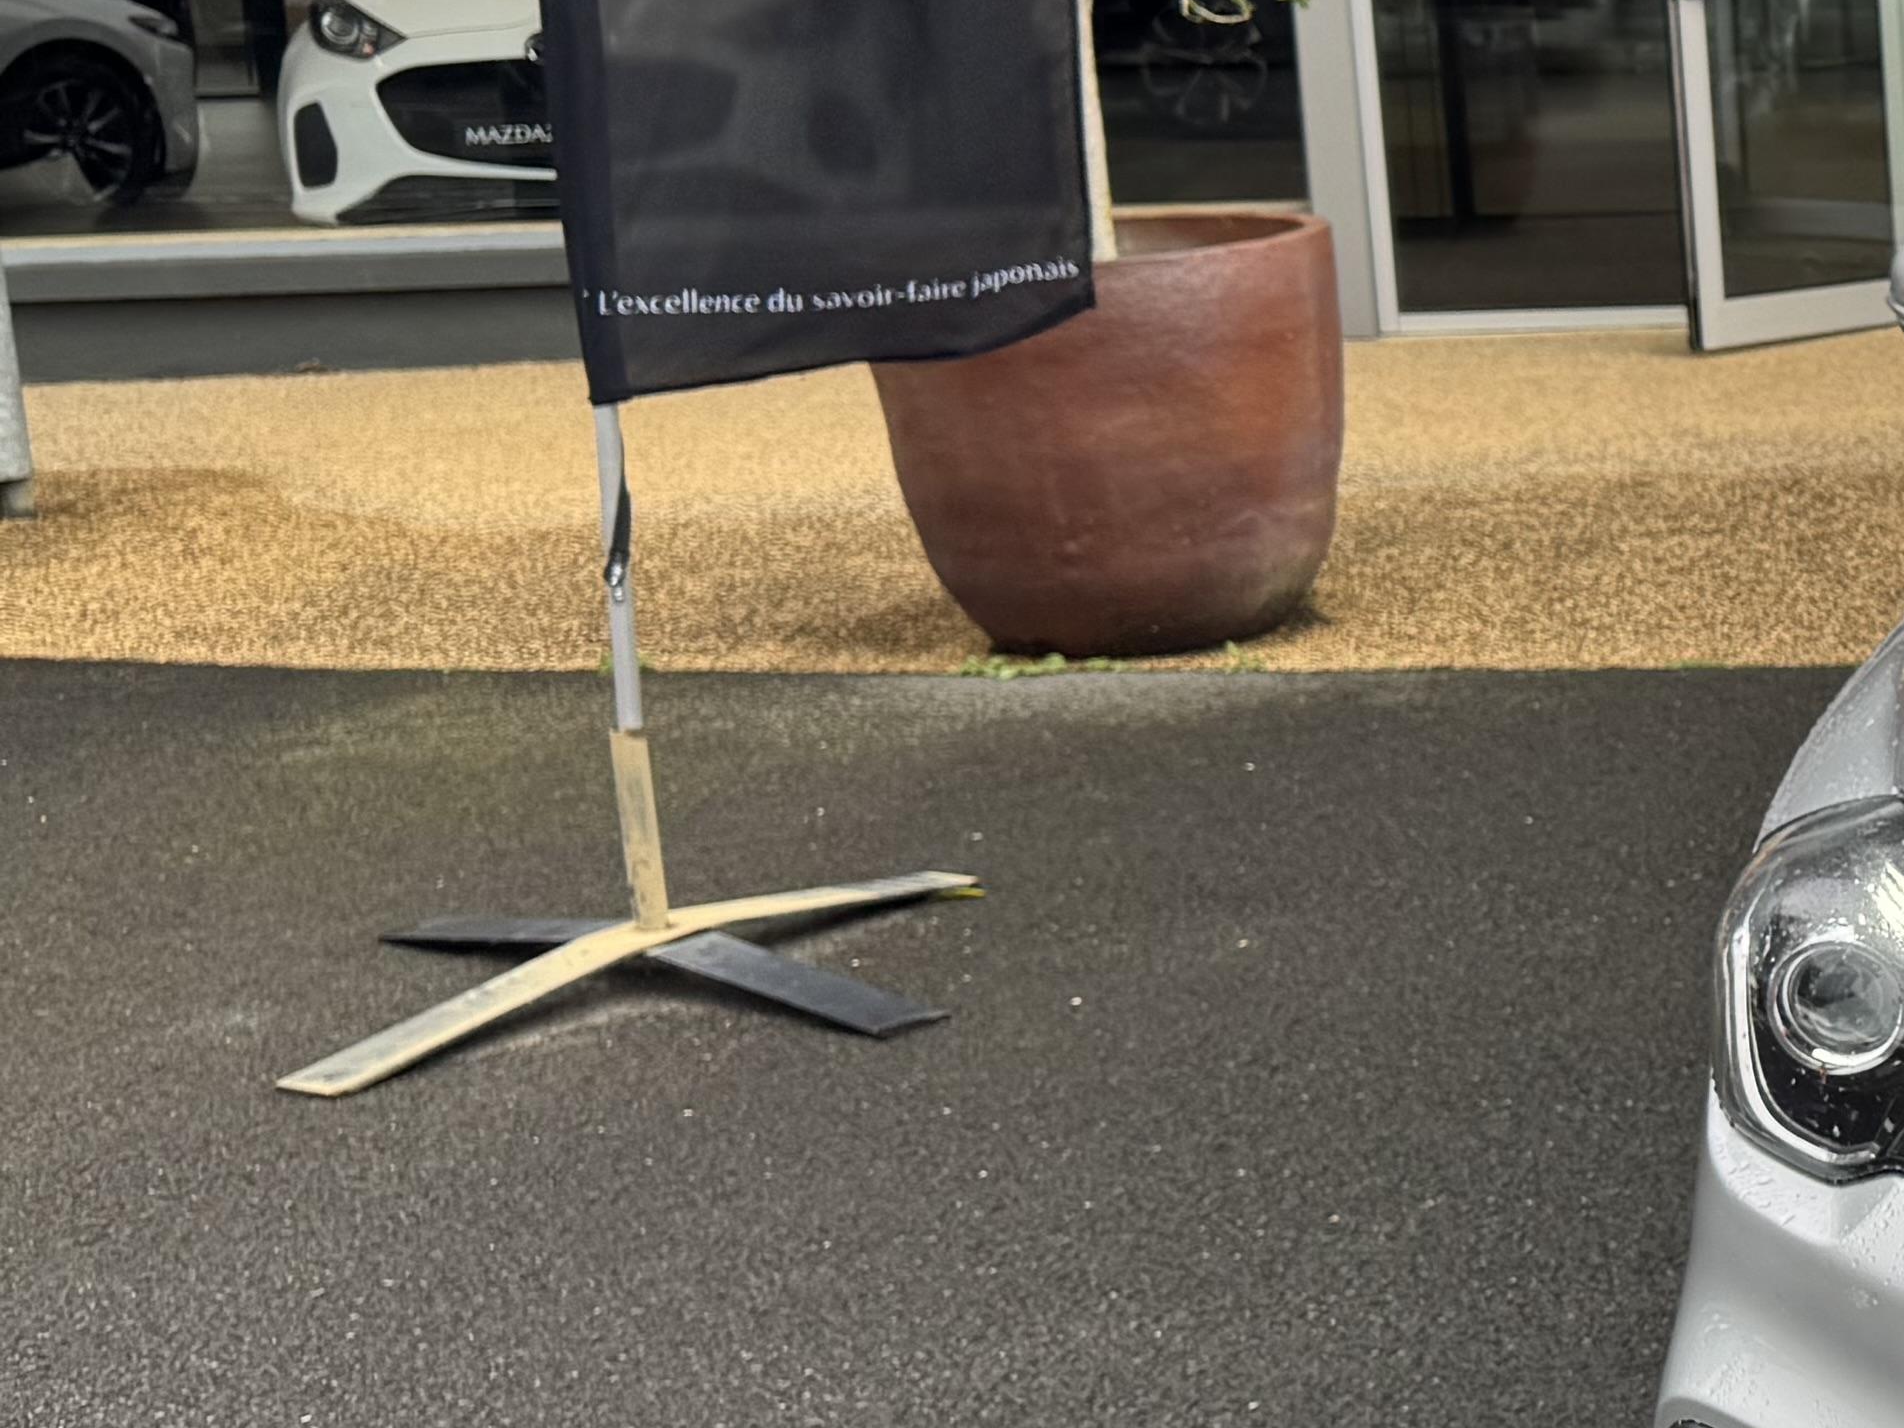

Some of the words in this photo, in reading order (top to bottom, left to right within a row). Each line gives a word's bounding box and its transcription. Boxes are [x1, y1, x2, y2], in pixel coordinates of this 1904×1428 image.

[767, 287, 804, 314] du
[812, 278, 967, 310] savoir-faire
[970, 255, 1080, 301] japonais
